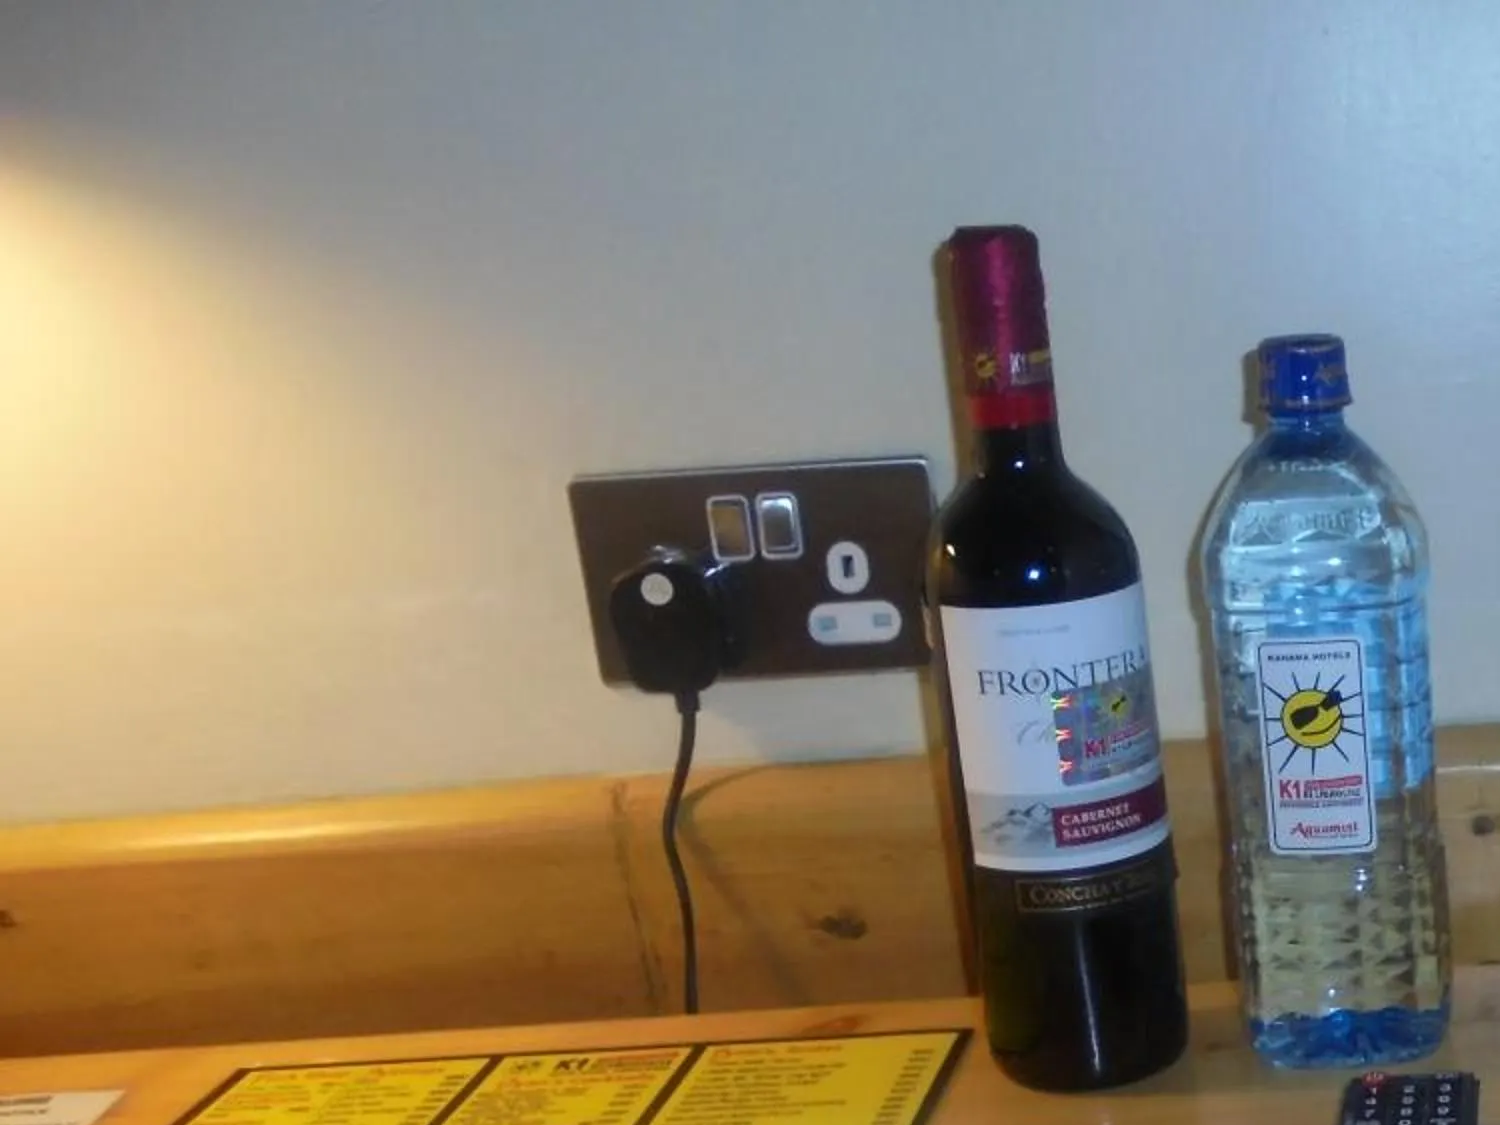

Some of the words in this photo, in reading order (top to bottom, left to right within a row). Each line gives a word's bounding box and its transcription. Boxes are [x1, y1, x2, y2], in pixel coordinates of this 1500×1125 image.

[1279, 779, 1301, 799] K1
[1061, 802, 1129, 826] CABERNET
[1062, 813, 1141, 841] SAUVIGNON
